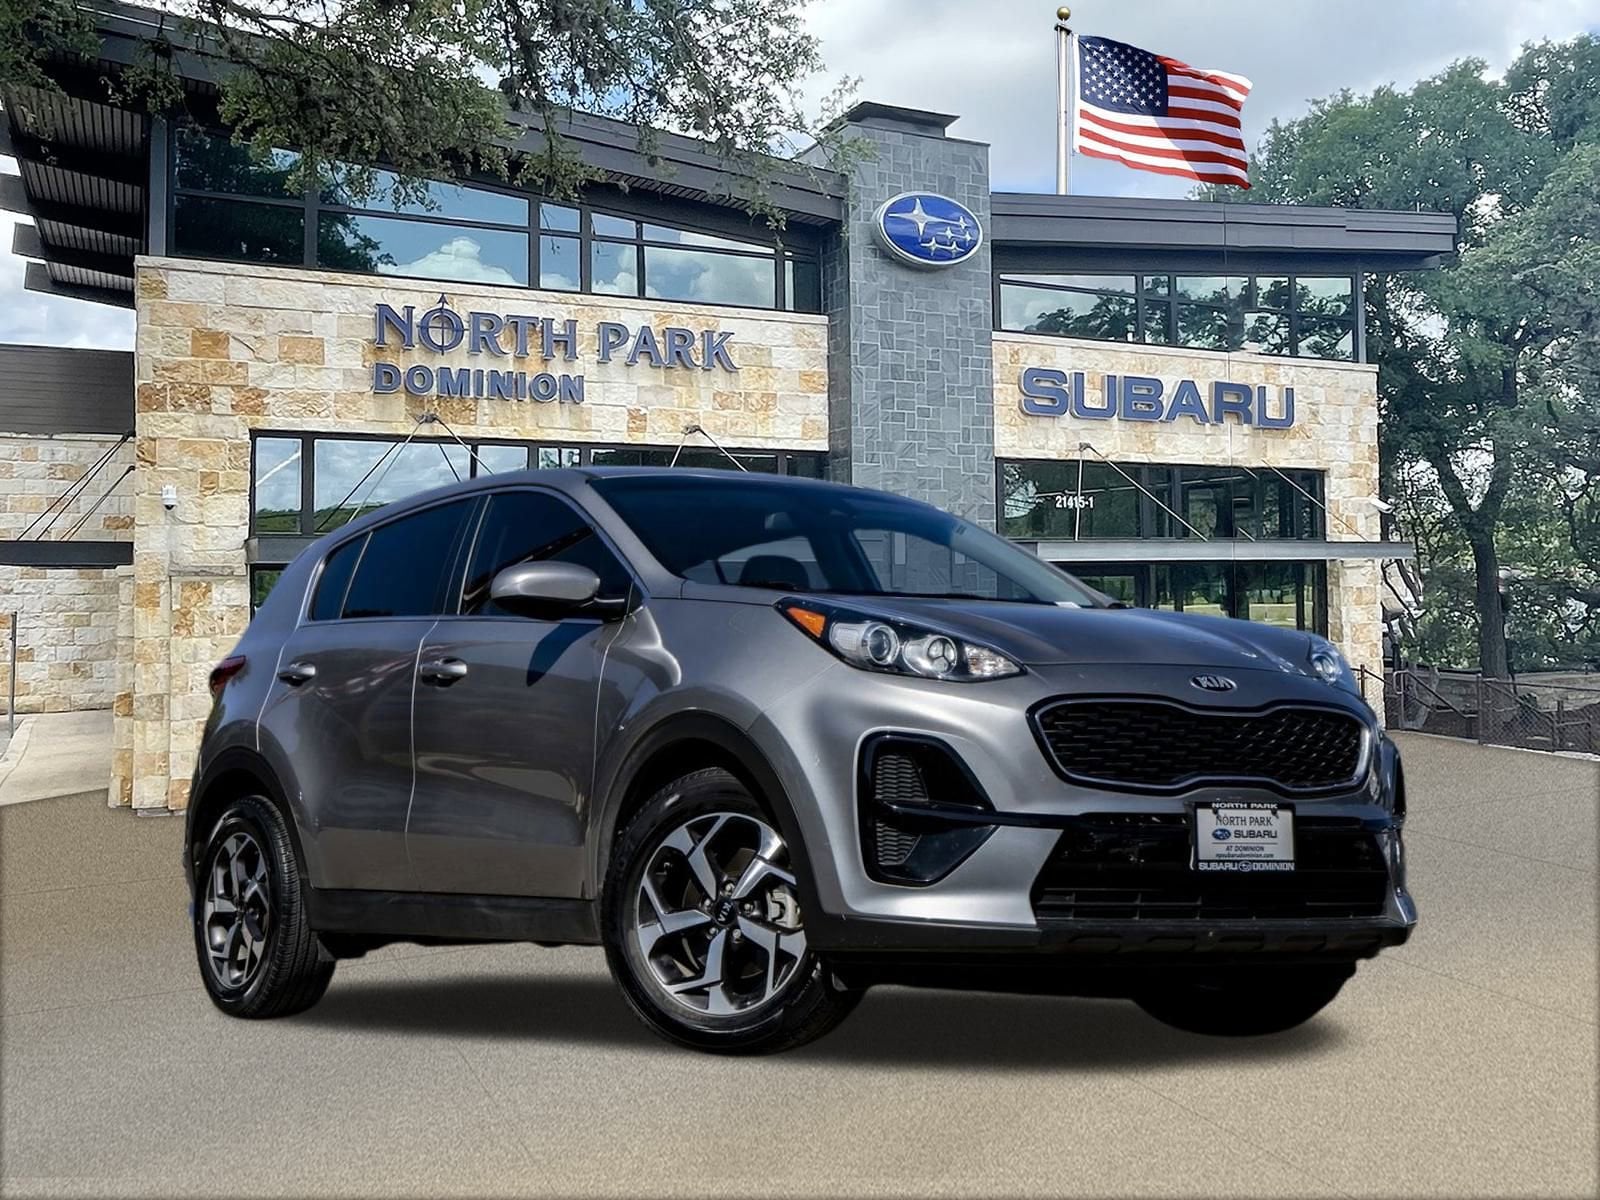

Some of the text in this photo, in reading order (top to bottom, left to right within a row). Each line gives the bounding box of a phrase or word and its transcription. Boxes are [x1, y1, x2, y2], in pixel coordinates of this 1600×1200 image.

[374, 300, 742, 373] NORTH PARK
[373, 362, 585, 405] DOMINION
[1019, 367, 1295, 430] SUBARU
[1196, 676, 1232, 689] KIA
[1216, 815, 1273, 826] NORTH PARK
[1234, 830, 1278, 839] SUBARU
[1199, 862, 1295, 871] SUBARU DOMINION
